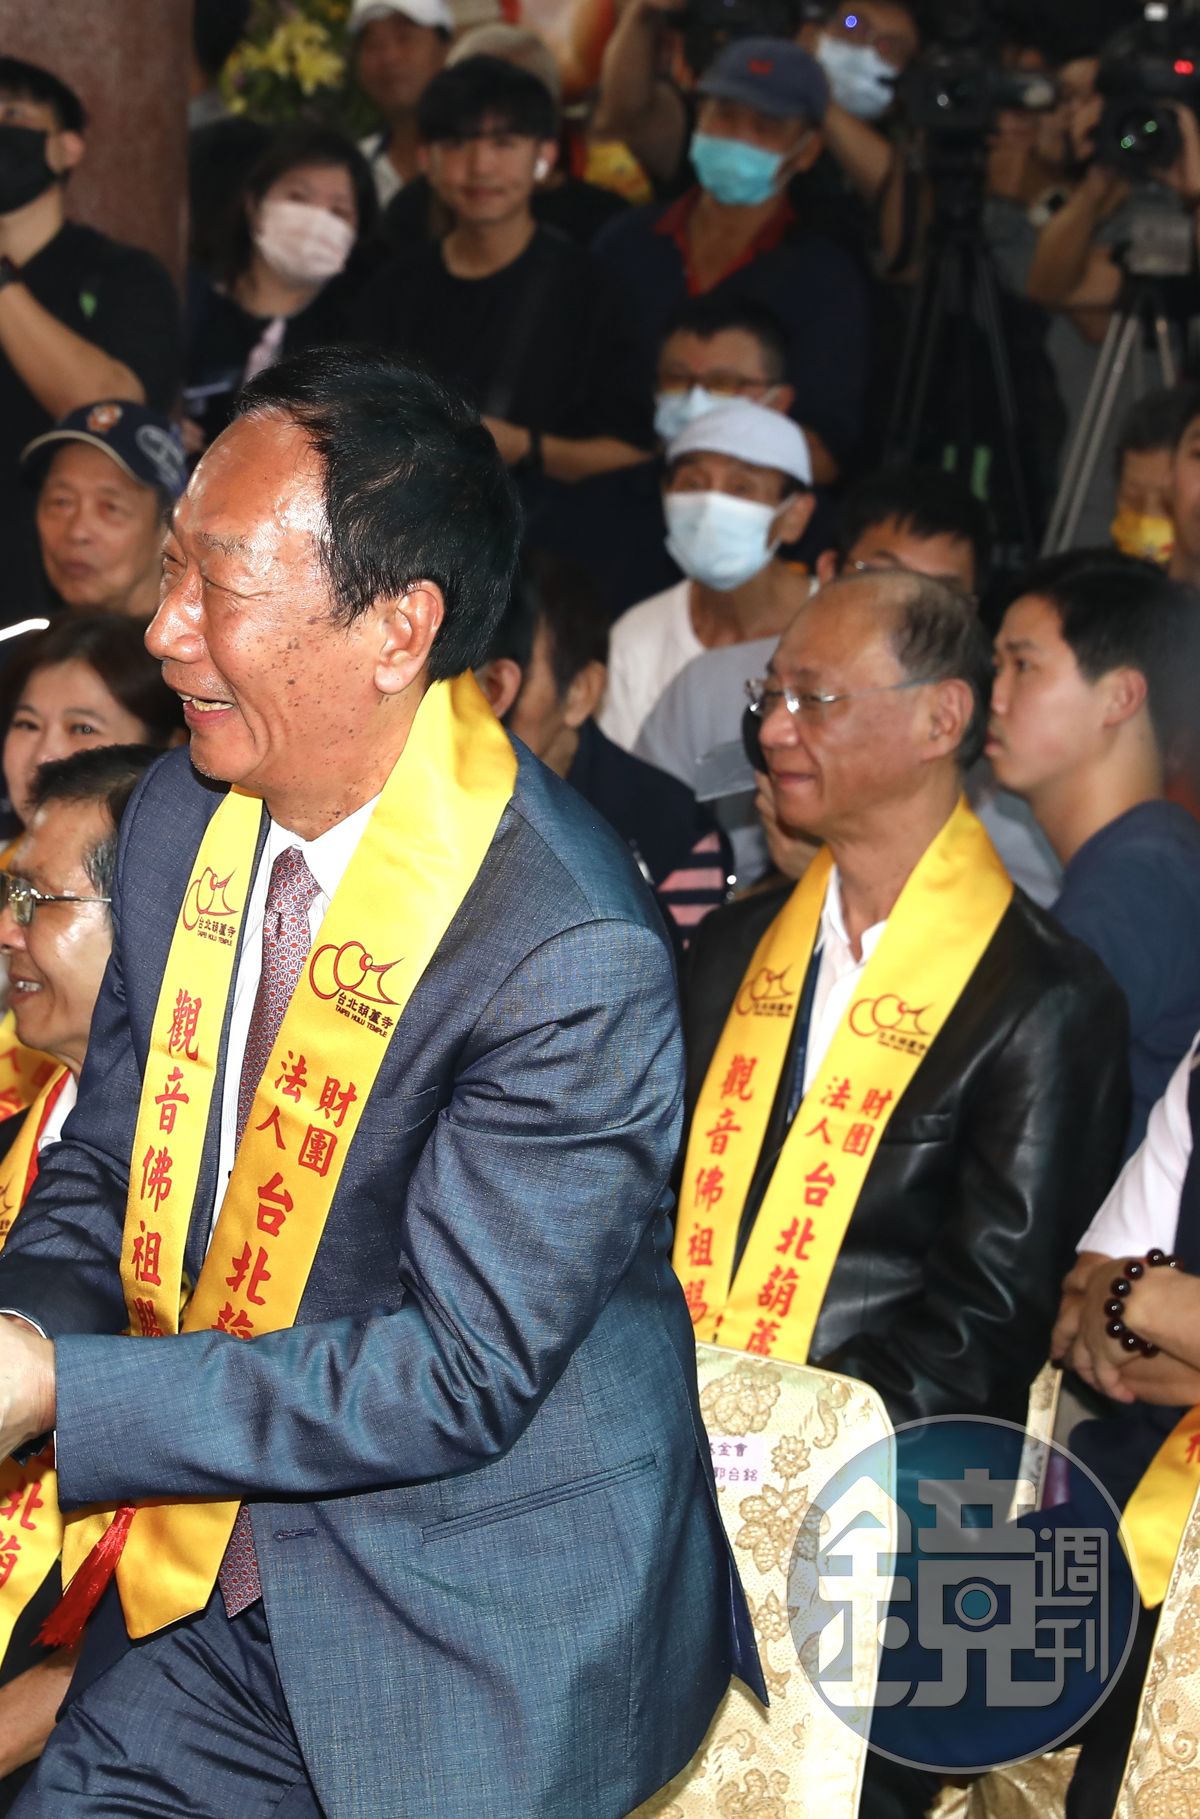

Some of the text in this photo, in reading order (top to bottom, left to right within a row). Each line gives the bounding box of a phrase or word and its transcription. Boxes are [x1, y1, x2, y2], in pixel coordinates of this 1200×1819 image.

[337, 991, 394, 1029] 台北葫蘆寺
